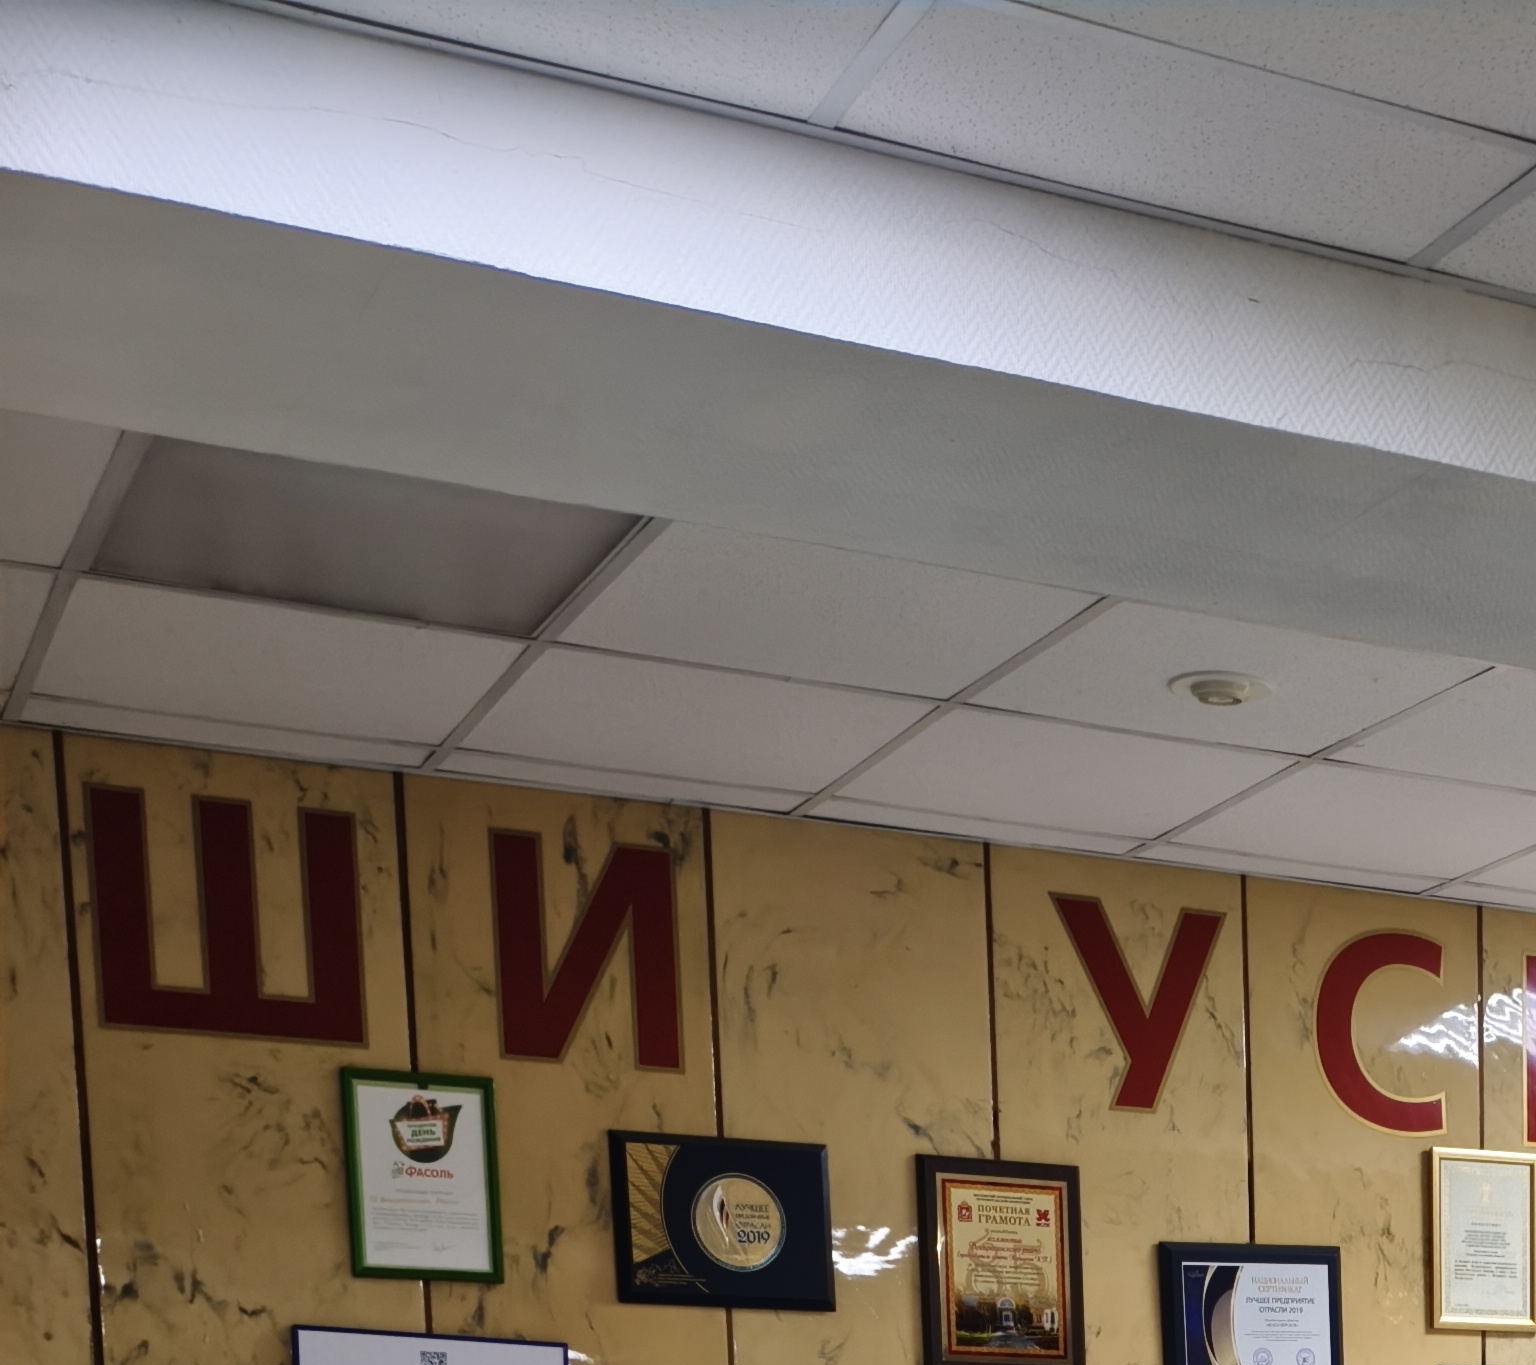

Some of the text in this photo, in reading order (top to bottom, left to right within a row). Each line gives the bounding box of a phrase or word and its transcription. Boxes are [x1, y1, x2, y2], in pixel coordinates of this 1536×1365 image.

[405, 1165, 454, 1180] ФАСОЛЬ
[977, 1204, 1031, 1215] ПОЧЕТНАЯ
[978, 1213, 1031, 1227] ГРАМОТА
[737, 1229, 771, 1245] 2019
